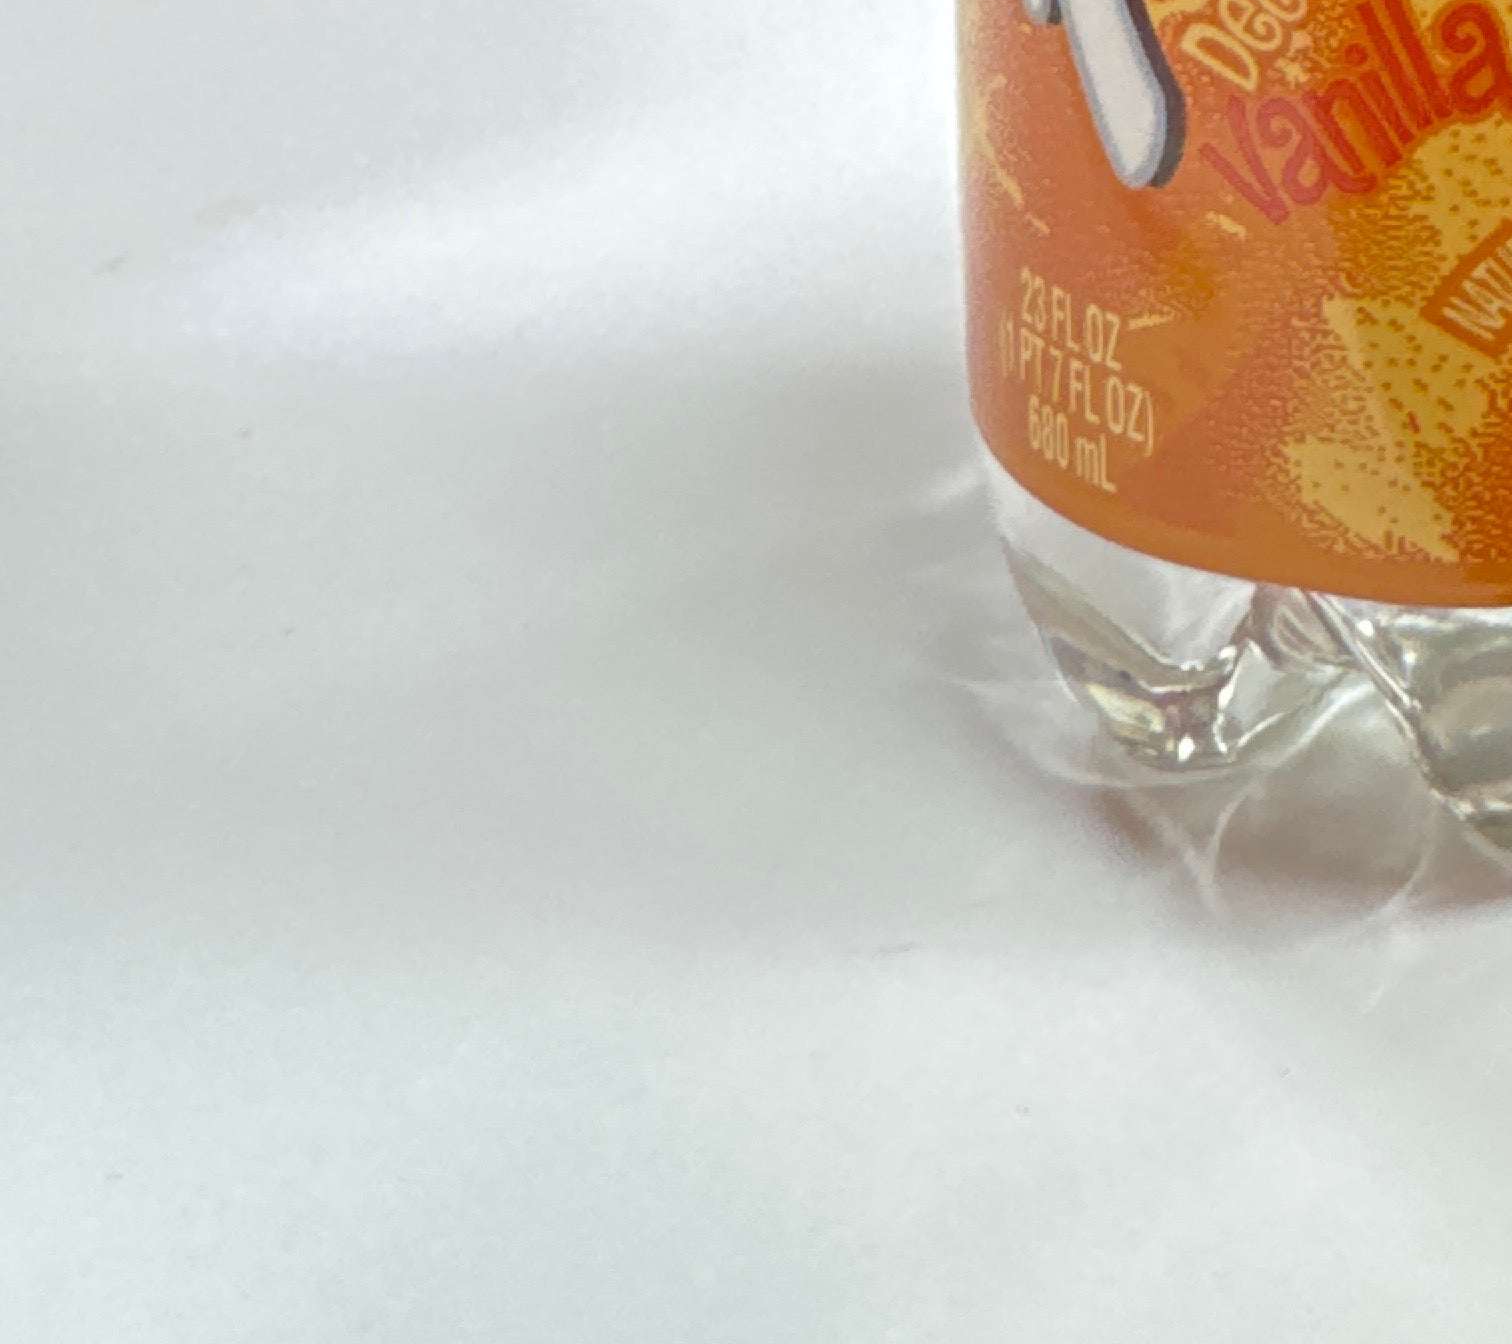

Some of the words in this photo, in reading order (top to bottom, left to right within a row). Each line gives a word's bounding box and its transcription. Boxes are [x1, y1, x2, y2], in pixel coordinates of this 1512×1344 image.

[1019, 266, 1047, 333] 23
[1051, 283, 1080, 353] FL
[1085, 303, 1123, 373] OZ
[1019, 325, 1046, 396] PT
[1049, 343, 1064, 404] 7
[1069, 357, 1101, 426] FL
[1027, 392, 1070, 471] 680
[1075, 431, 1118, 495] mL
